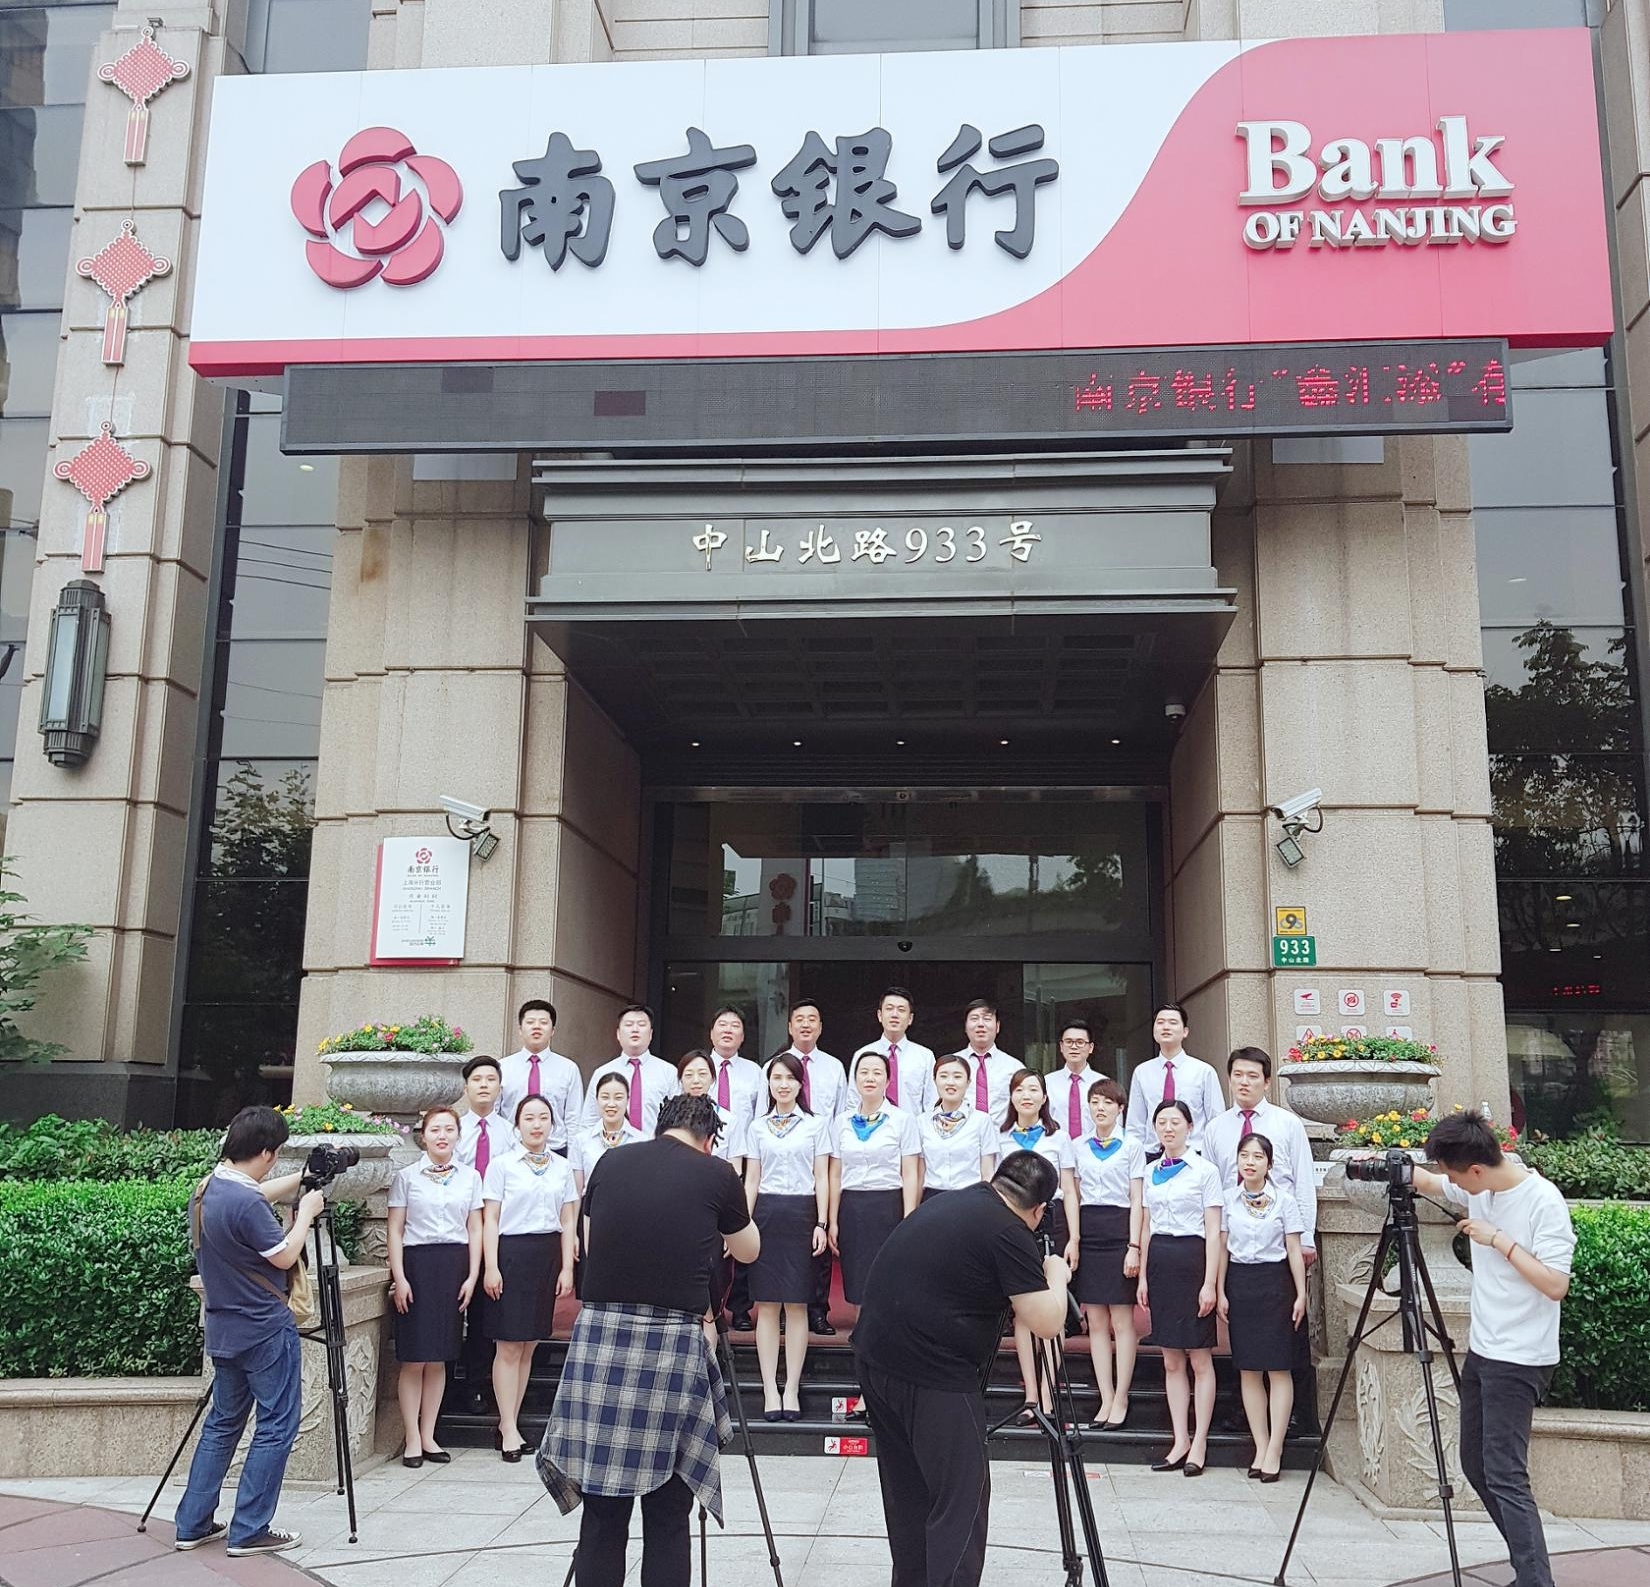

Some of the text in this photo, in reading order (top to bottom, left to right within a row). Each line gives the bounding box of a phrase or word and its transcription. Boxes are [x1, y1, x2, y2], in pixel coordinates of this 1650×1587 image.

[1235, 115, 1516, 206] Bank
[1242, 204, 1518, 250] OF NANJING
[692, 520, 1042, 571] 中山北路933号
[1280, 939, 1310, 955] 933
